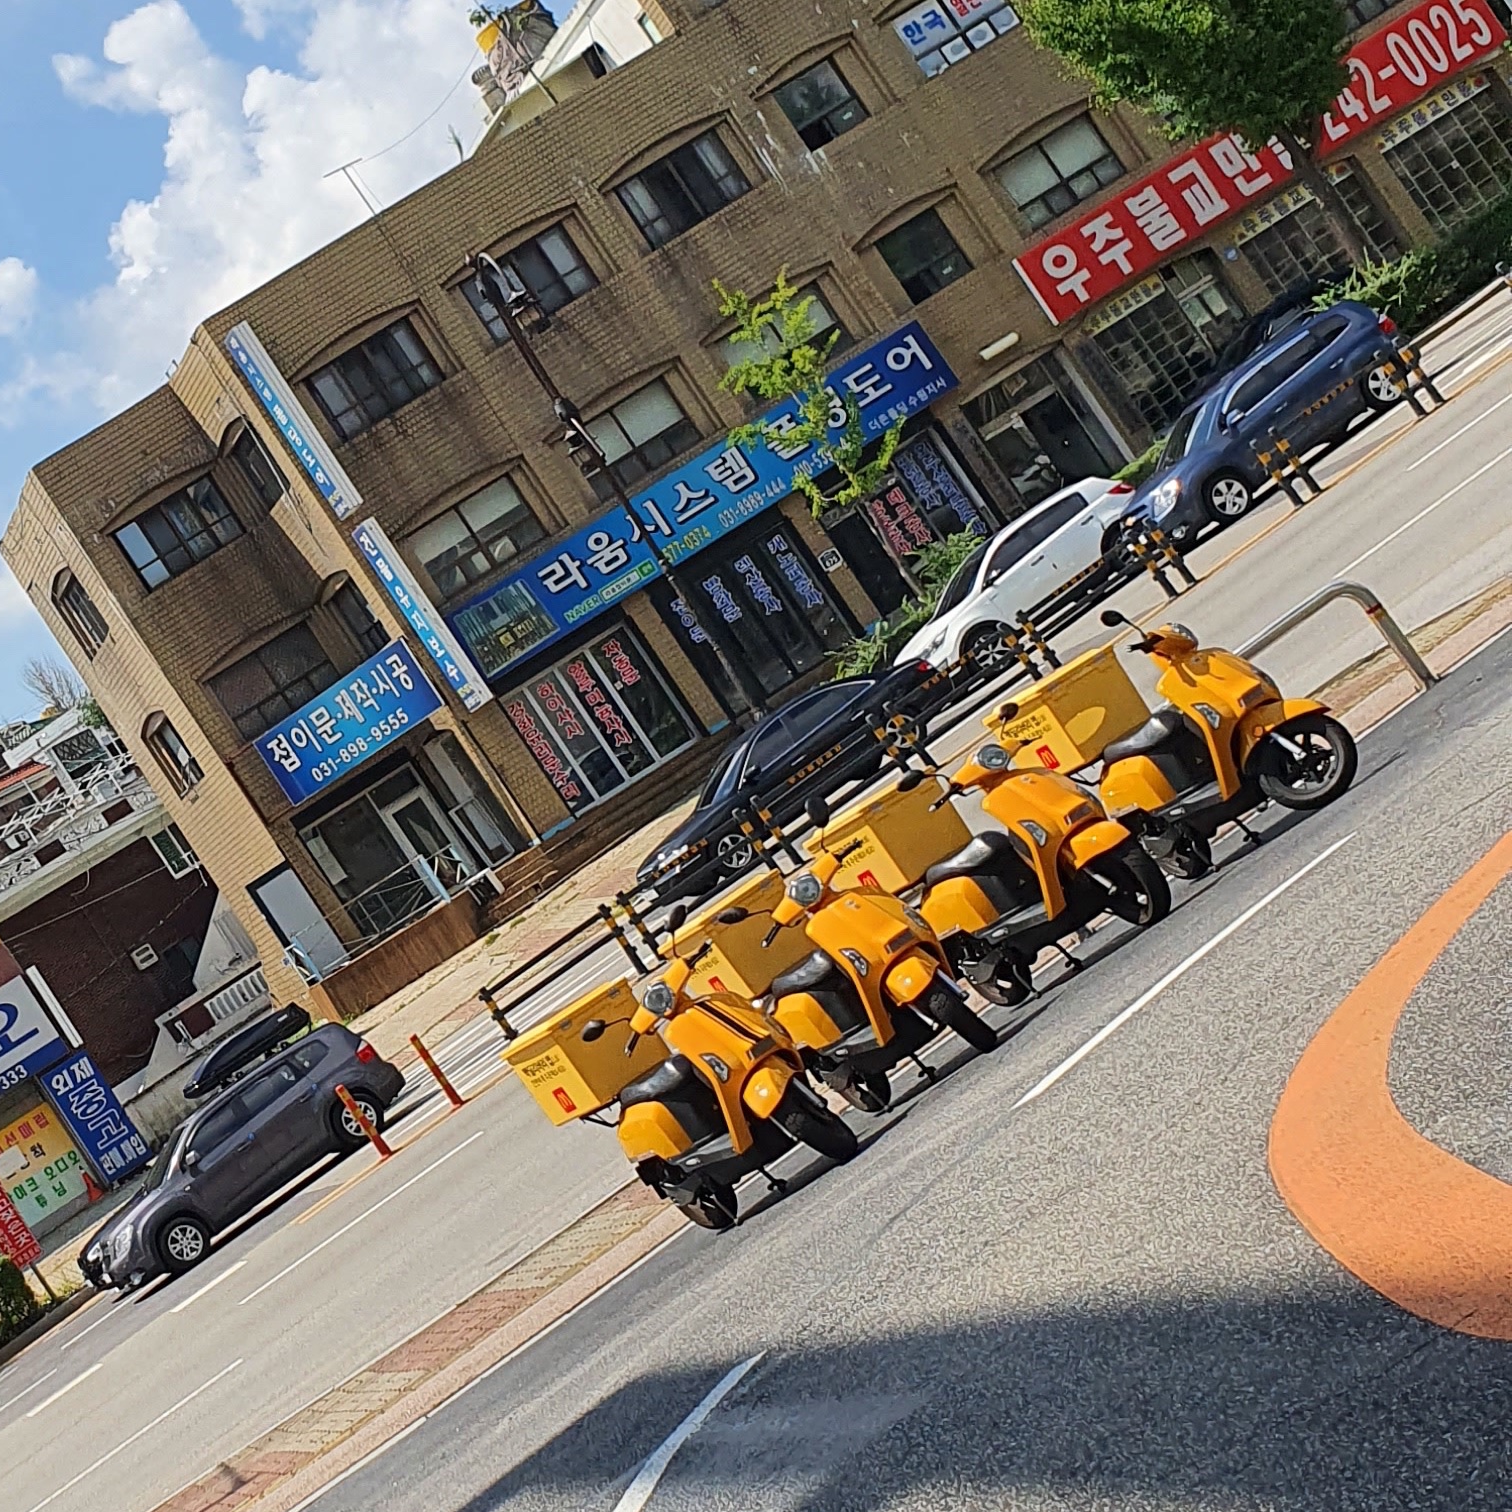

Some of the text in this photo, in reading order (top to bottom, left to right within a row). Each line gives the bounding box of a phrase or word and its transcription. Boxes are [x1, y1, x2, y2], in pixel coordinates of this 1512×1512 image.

[899, 5, 947, 48] 한국
[1041, 120, 1312, 303] 우주불교만
[533, 443, 758, 606] 라움시스템
[562, 593, 601, 622] NAVER
[600, 636, 642, 687] 자동문
[309, 706, 410, 784] 031-898-9555
[48, 1056, 96, 1096] 외제
[64, 1077, 129, 1150] 중고
[42, 1149, 81, 1181] 오디오
[34, 1180, 67, 1208] 튜닝
